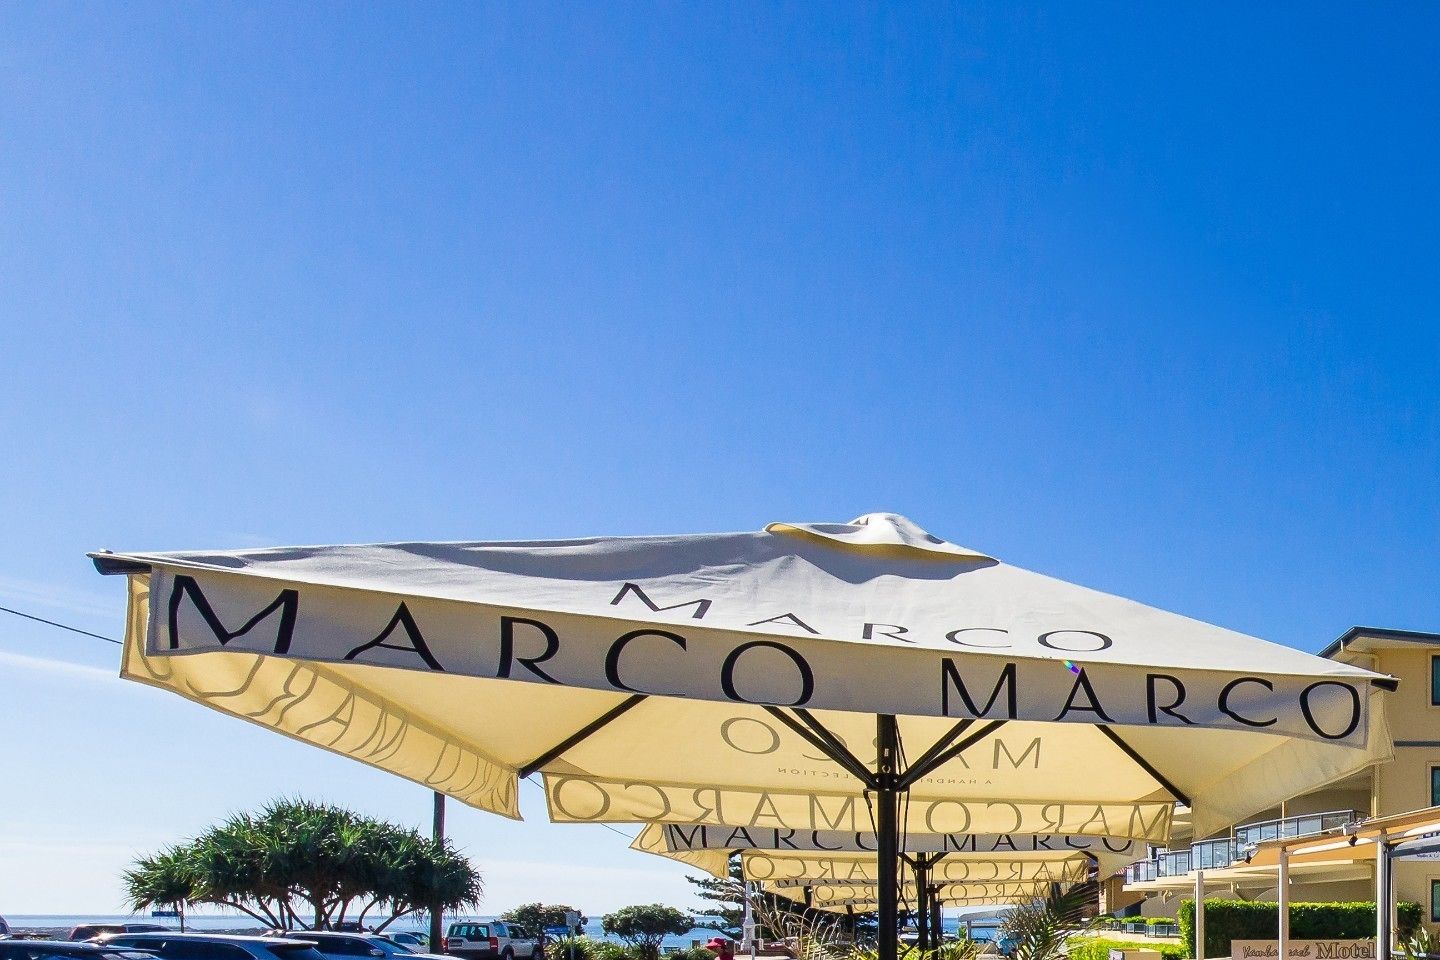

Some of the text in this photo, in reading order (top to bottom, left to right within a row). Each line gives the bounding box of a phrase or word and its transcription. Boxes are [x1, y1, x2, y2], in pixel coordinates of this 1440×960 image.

[610, 582, 1114, 653] MARCO
[167, 574, 1362, 741] MARCO MARCO
[1315, 941, 1376, 960] Motel
